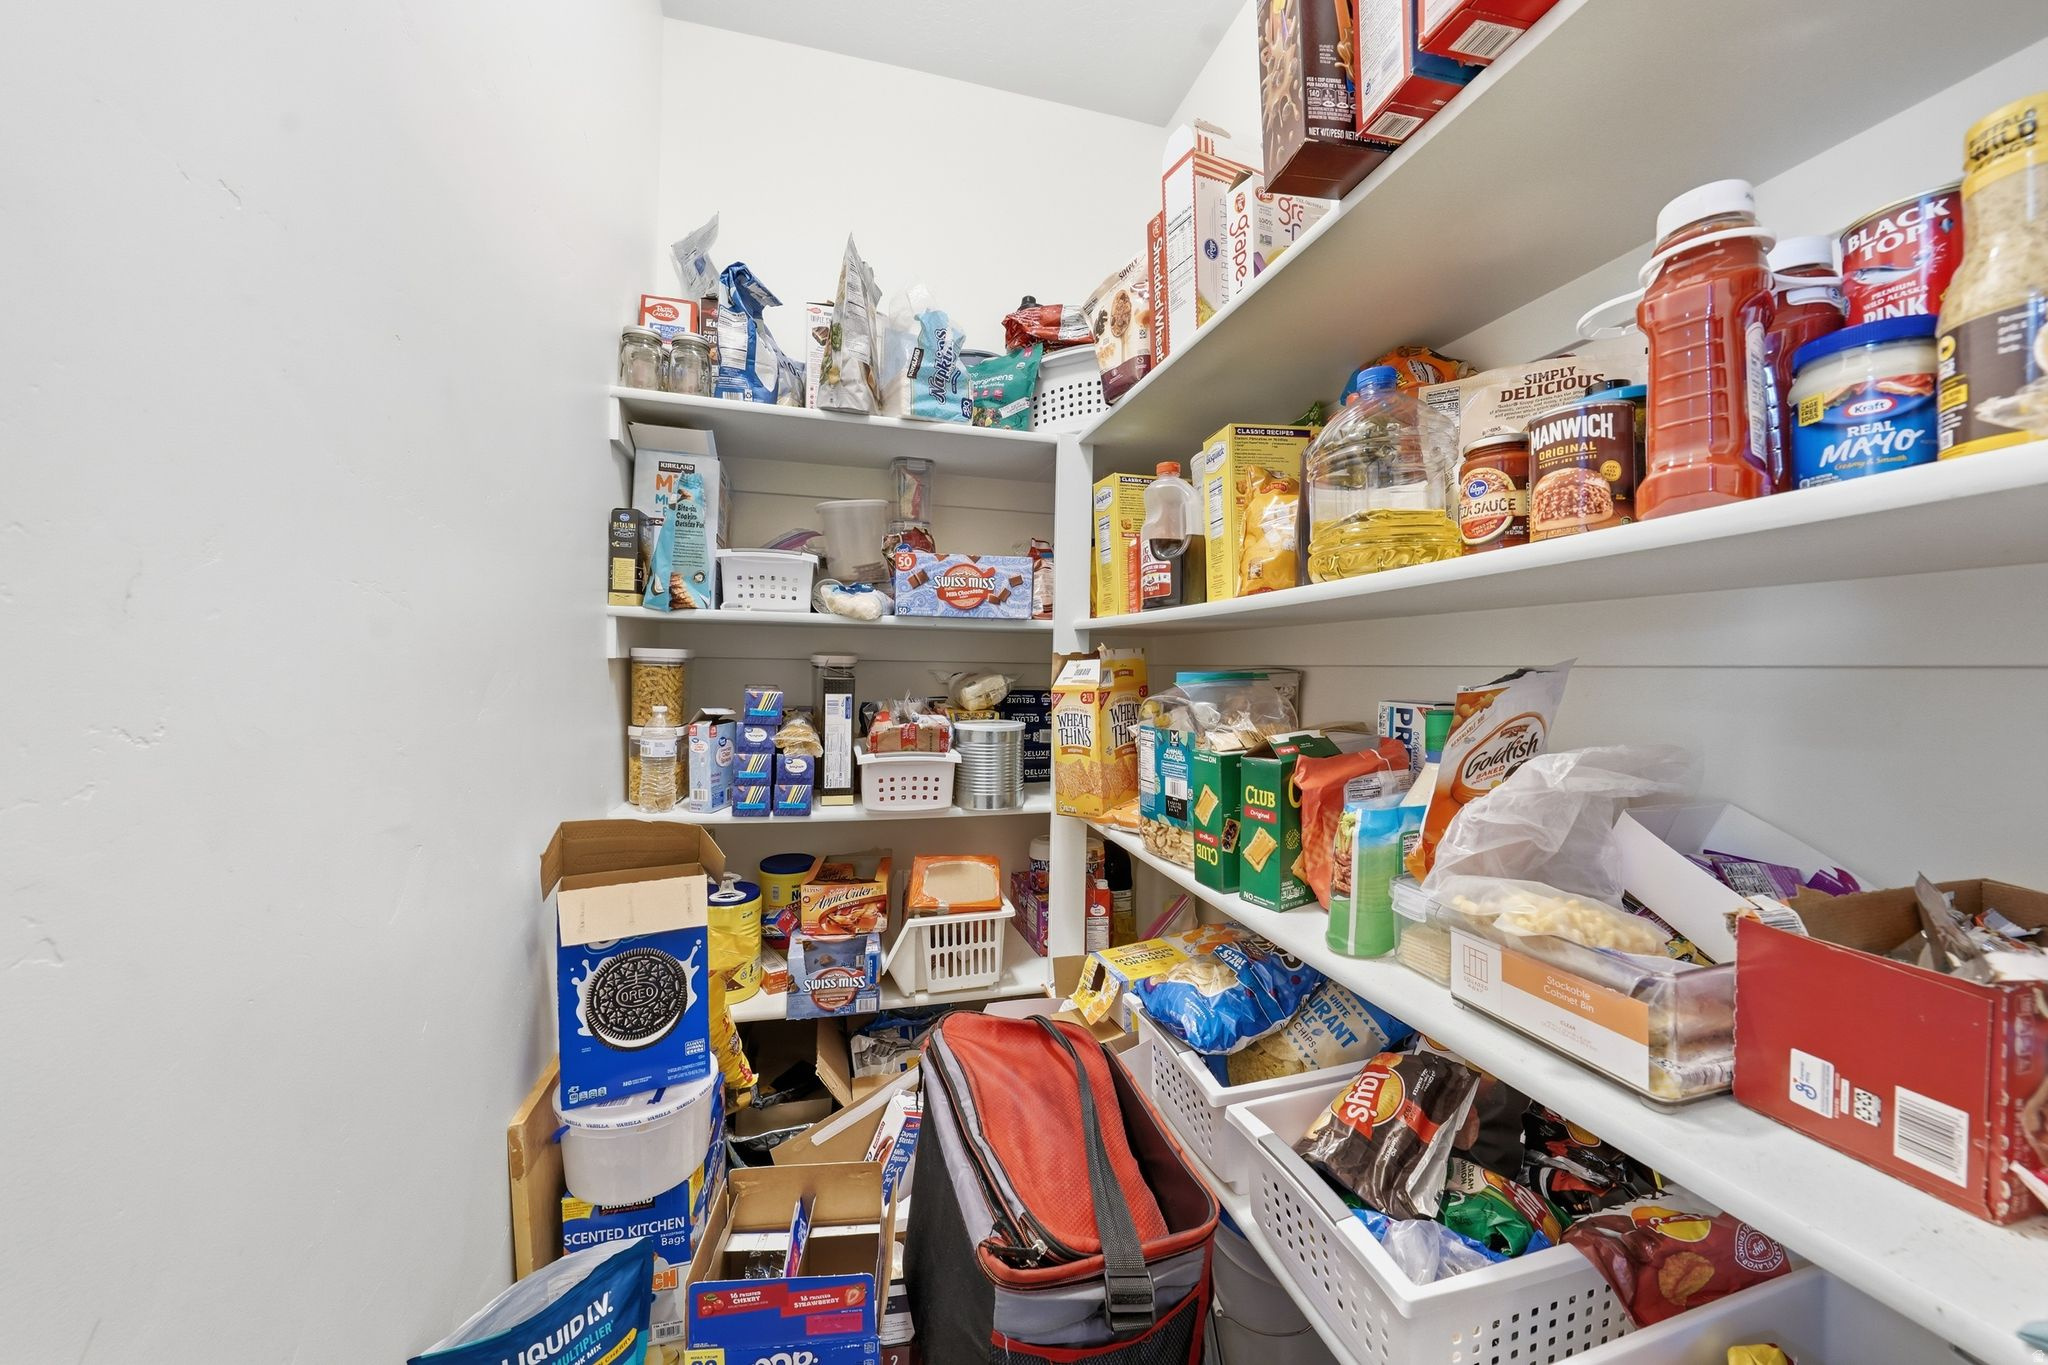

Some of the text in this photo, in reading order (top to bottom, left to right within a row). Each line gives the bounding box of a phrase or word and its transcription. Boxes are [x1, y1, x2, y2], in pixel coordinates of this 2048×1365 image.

[1308, 127, 1319, 136] NET
[1847, 198, 1951, 254] BLACK
[1860, 224, 1929, 261] TOP
[1153, 237, 1165, 364] Shredded Wheat
[1863, 285, 1929, 311] WILD ALASKA
[1871, 280, 1917, 300] PREMIUM
[1863, 294, 1929, 324] PINK
[928, 328, 954, 405] Napkins
[1524, 365, 1577, 386] SIMPLY
[1500, 374, 1605, 403] DELICIOUS
[1853, 402, 1886, 413] Kraft
[1530, 412, 1614, 456] MANWICH
[1846, 420, 1896, 438] REAL
[1538, 441, 1597, 461] ORIGINAL
[1818, 429, 1925, 468] MAYO
[660, 462, 694, 471] KIRKLAND
[1473, 498, 1516, 515] SAUCE
[898, 556, 912, 567] 50
[934, 575, 995, 590] SWISS MISS
[1057, 713, 1091, 729] WHEAT
[1109, 703, 1142, 725] WHEAT
[1057, 727, 1092, 748] THINS
[1465, 731, 1539, 780] Goldfish
[1476, 764, 1506, 780] BAKED
[1245, 785, 1276, 808] CLUB
[1250, 810, 1270, 820] Original
[1196, 844, 1218, 866] CLUB
[810, 891, 846, 911] Apple
[1243, 891, 1254, 900] NO
[1115, 947, 1175, 964] MANDARIN
[1124, 952, 1175, 967] ORANGES
[621, 986, 654, 1002] OREO
[803, 976, 866, 993] SWISS MISS
[1546, 975, 1592, 1001] Stackable
[1328, 994, 1351, 1019] WHITE
[1543, 984, 1595, 1014] Cabinet Bin
[1308, 997, 1359, 1049] URANT
[1293, 1021, 1317, 1048] CHIPS
[1344, 1071, 1391, 1124] Lay's
[564, 1216, 685, 1246] SCENTED KITCHEN
[661, 1235, 685, 1246] Bags
[586, 1291, 614, 1326] I.V.
[732, 1296, 761, 1304] CHERRY
[793, 1298, 840, 1309] STRAWBERRY
[551, 1323, 613, 1365] MULTIPLIER
[587, 1343, 602, 1360] MIX
